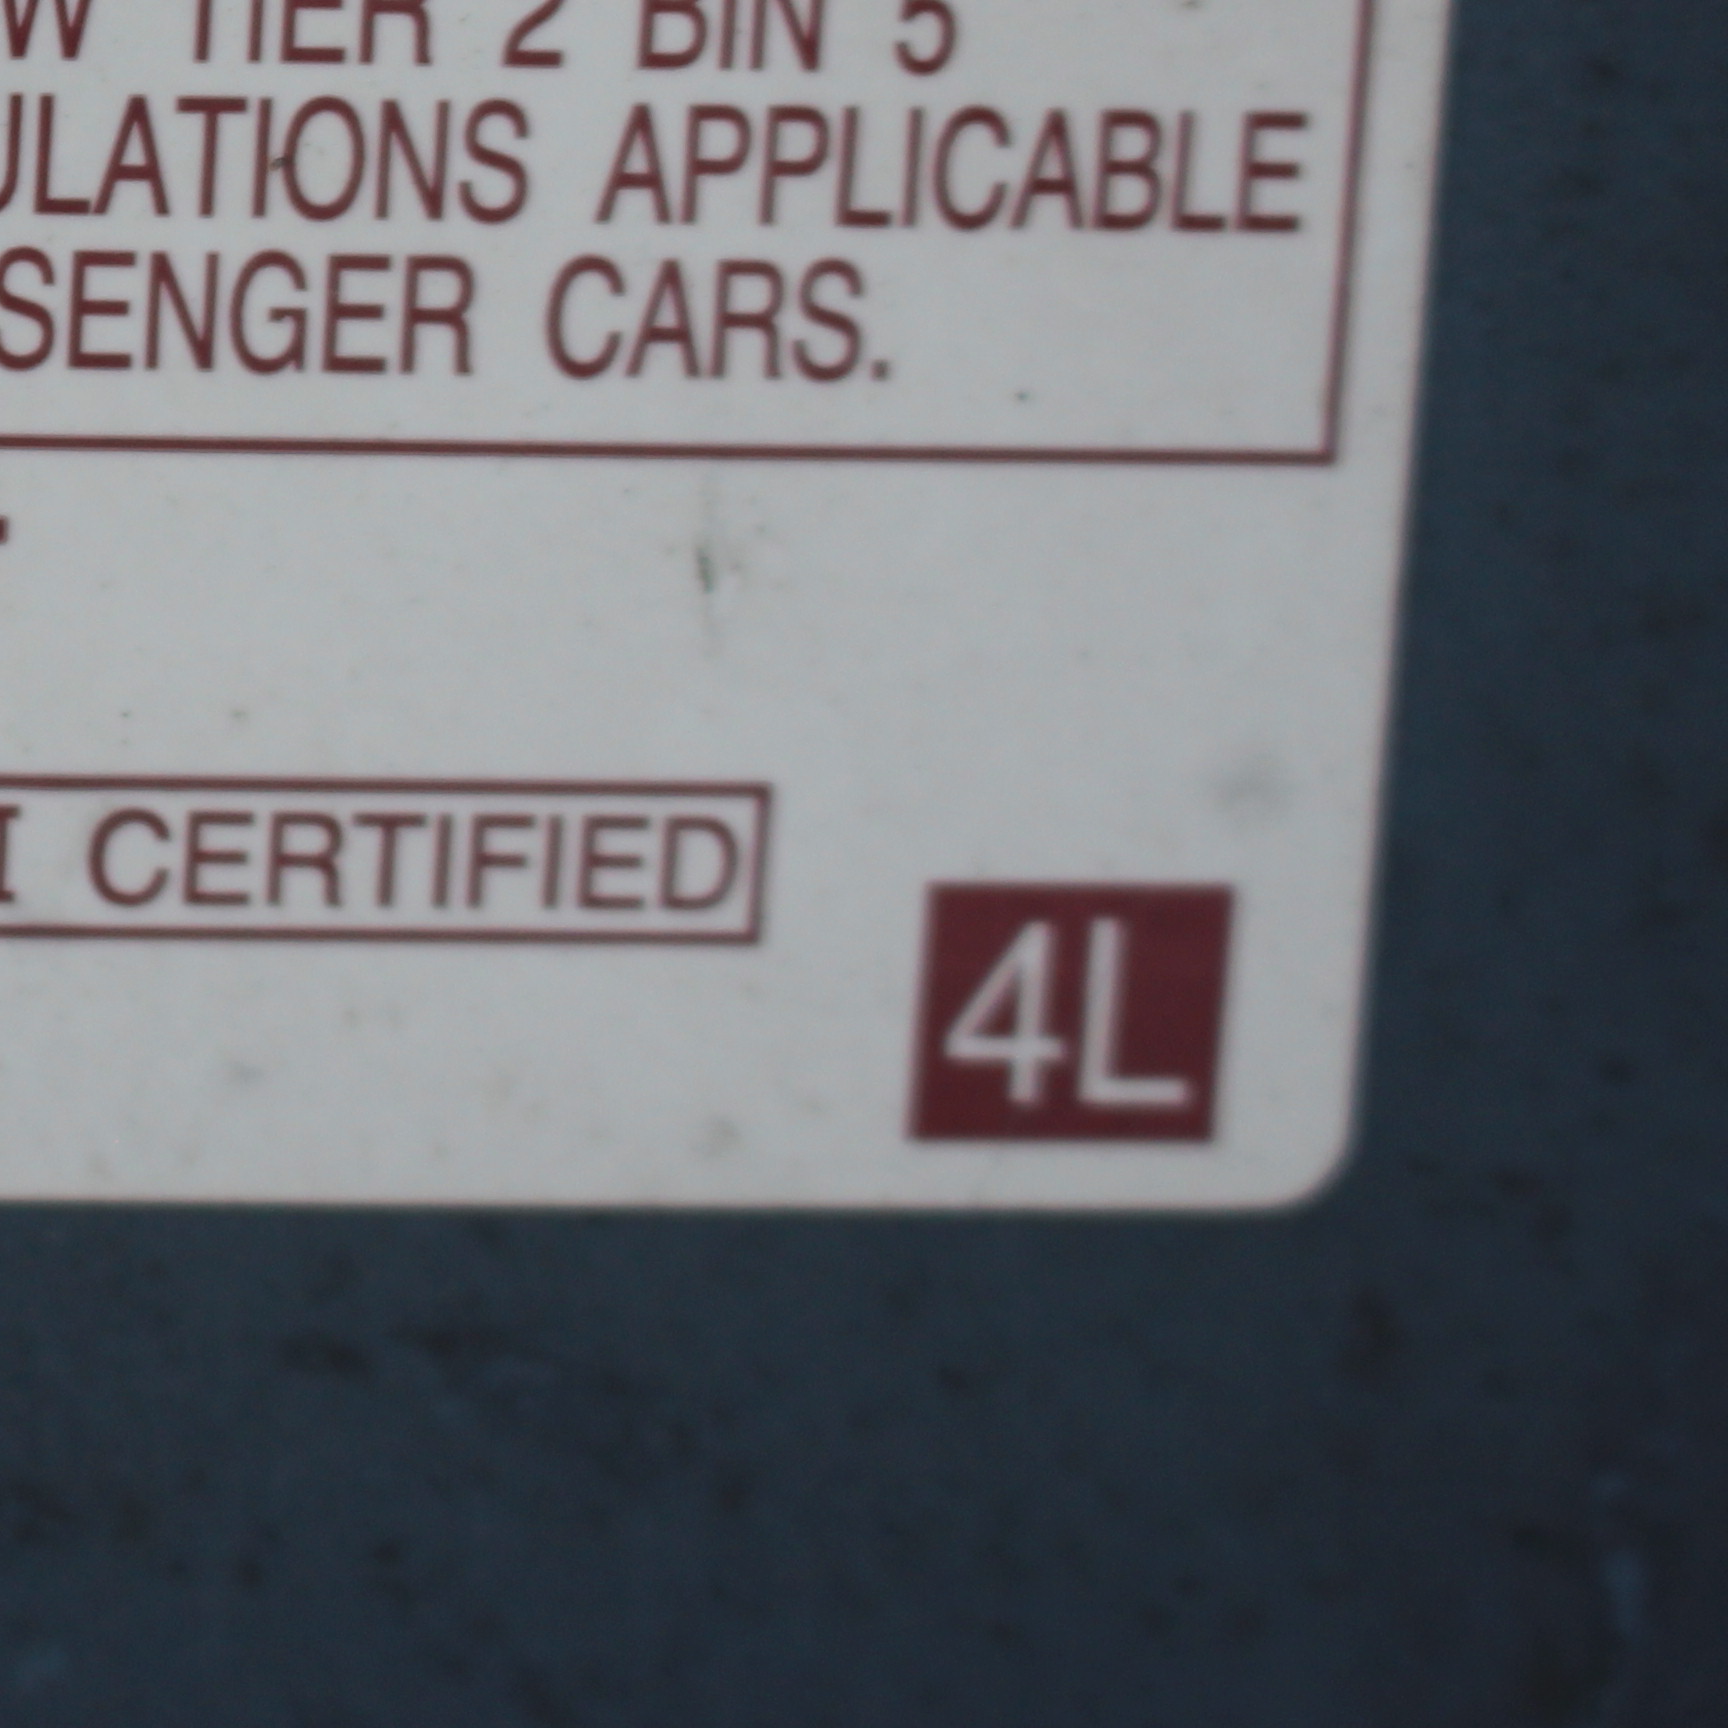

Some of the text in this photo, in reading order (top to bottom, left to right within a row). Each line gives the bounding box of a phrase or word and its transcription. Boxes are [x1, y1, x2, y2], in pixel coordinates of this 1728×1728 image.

[597, 104, 1308, 234] APPLICABLE
[546, 255, 888, 383] CARS.
[88, 808, 738, 911] CERTIFIED
[947, 920, 1185, 1104] 4L
